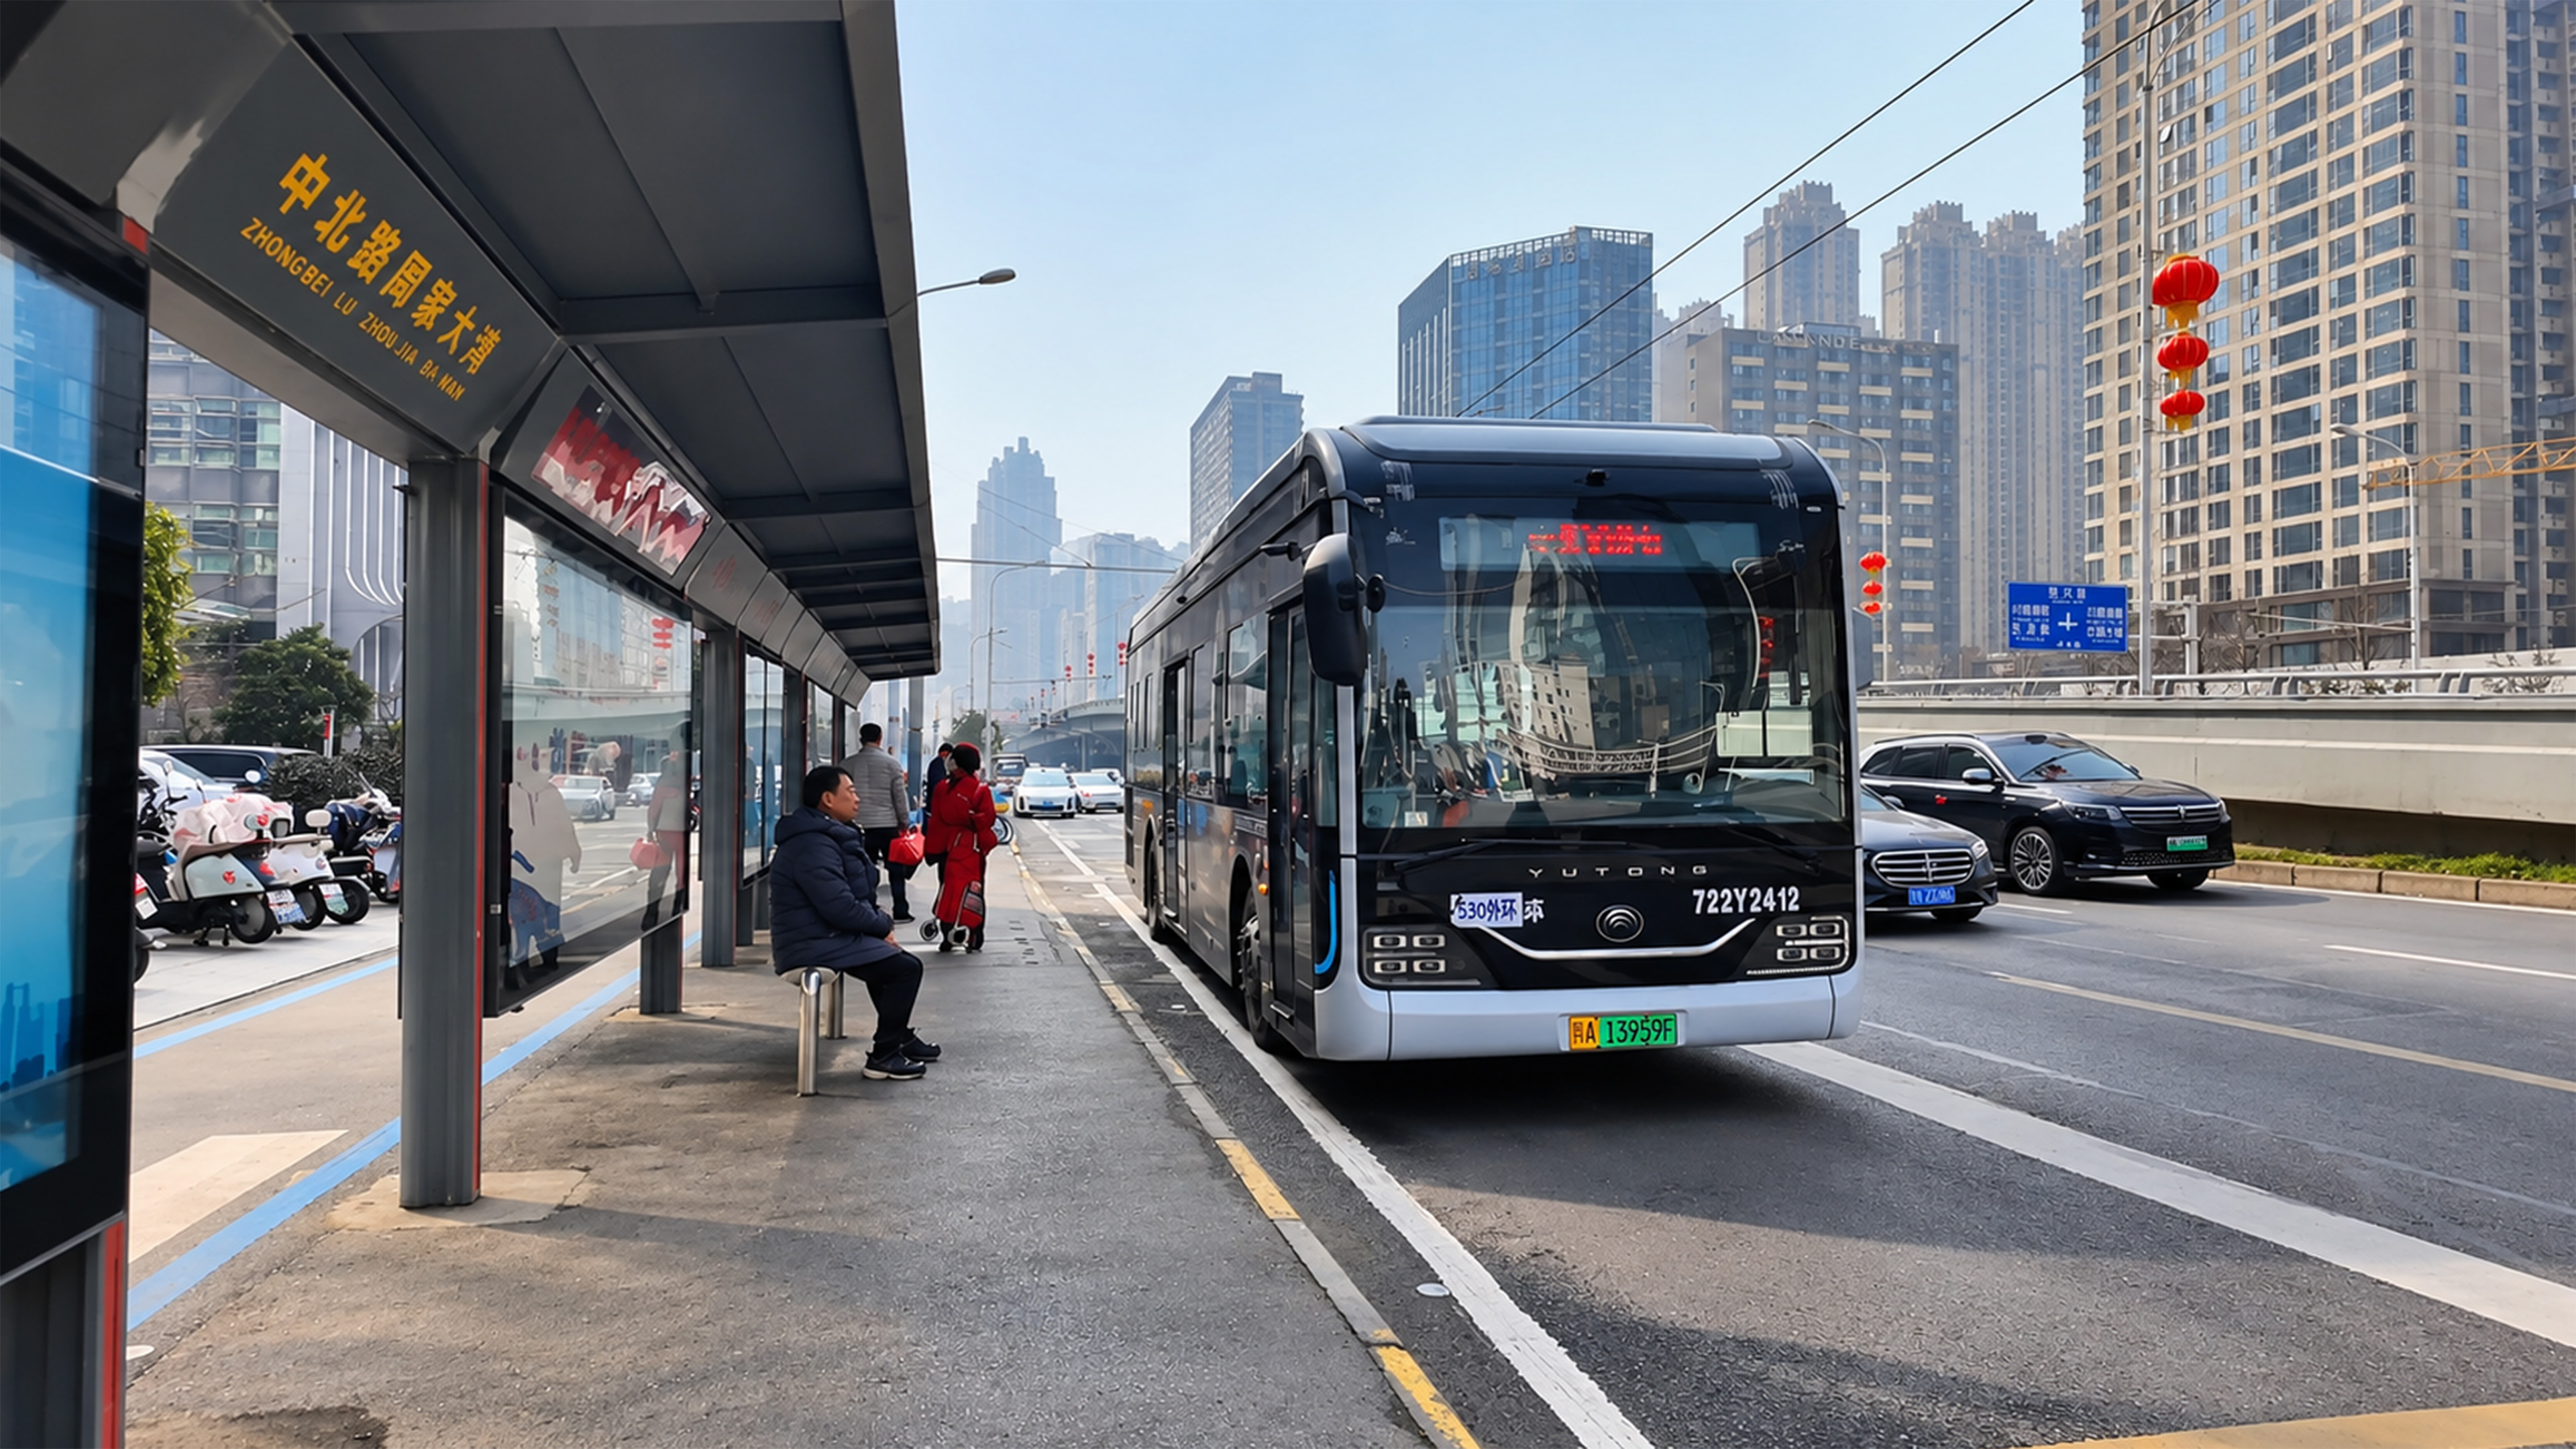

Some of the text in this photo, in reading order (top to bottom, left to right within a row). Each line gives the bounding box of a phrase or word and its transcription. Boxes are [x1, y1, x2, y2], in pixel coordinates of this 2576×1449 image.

[240, 217, 334, 299] ZHONGBEI
[333, 292, 358, 316] LU
[1528, 865, 1708, 879] YUTONG
[1458, 898, 1517, 922] 530外环
[1692, 885, 1801, 914] 722Y2412
